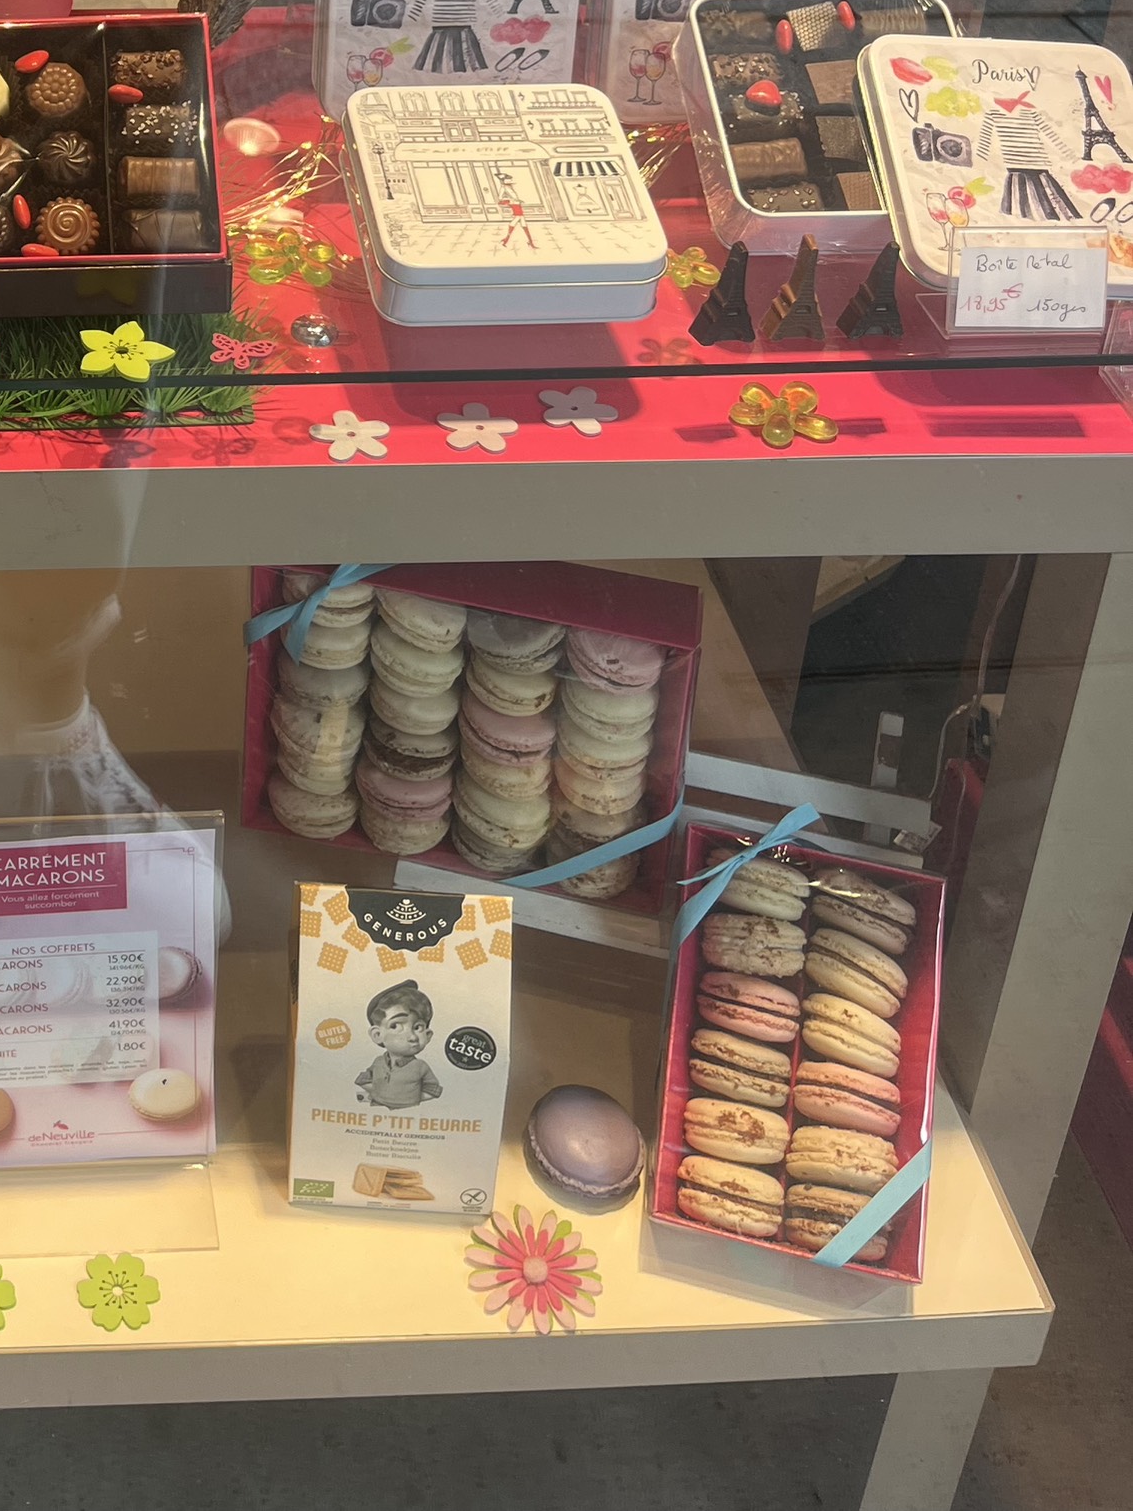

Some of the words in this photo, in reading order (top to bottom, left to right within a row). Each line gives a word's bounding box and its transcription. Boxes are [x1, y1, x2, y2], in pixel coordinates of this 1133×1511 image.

[971, 58, 1027, 84] Paris
[1, 895, 25, 903] Vous
[27, 893, 49, 901] allez
[51, 891, 100, 900] forcément
[24, 900, 77, 910] succomber
[363, 913, 448, 941] GENEROUS
[11, 946, 36, 956] NOS
[40, 943, 96, 954] COFFRETS
[318, 1025, 347, 1038] GLUTEN
[325, 1035, 345, 1046] FREE
[461, 1033, 487, 1049] great
[448, 1036, 493, 1064] taste
[311, 1108, 368, 1126] PIERRE
[372, 1114, 415, 1130] P'TIT
[419, 1117, 482, 1133] BEURRE
[28, 1130, 95, 1143] deNeuville
[345, 1128, 403, 1138] ACCIDENTALLY
